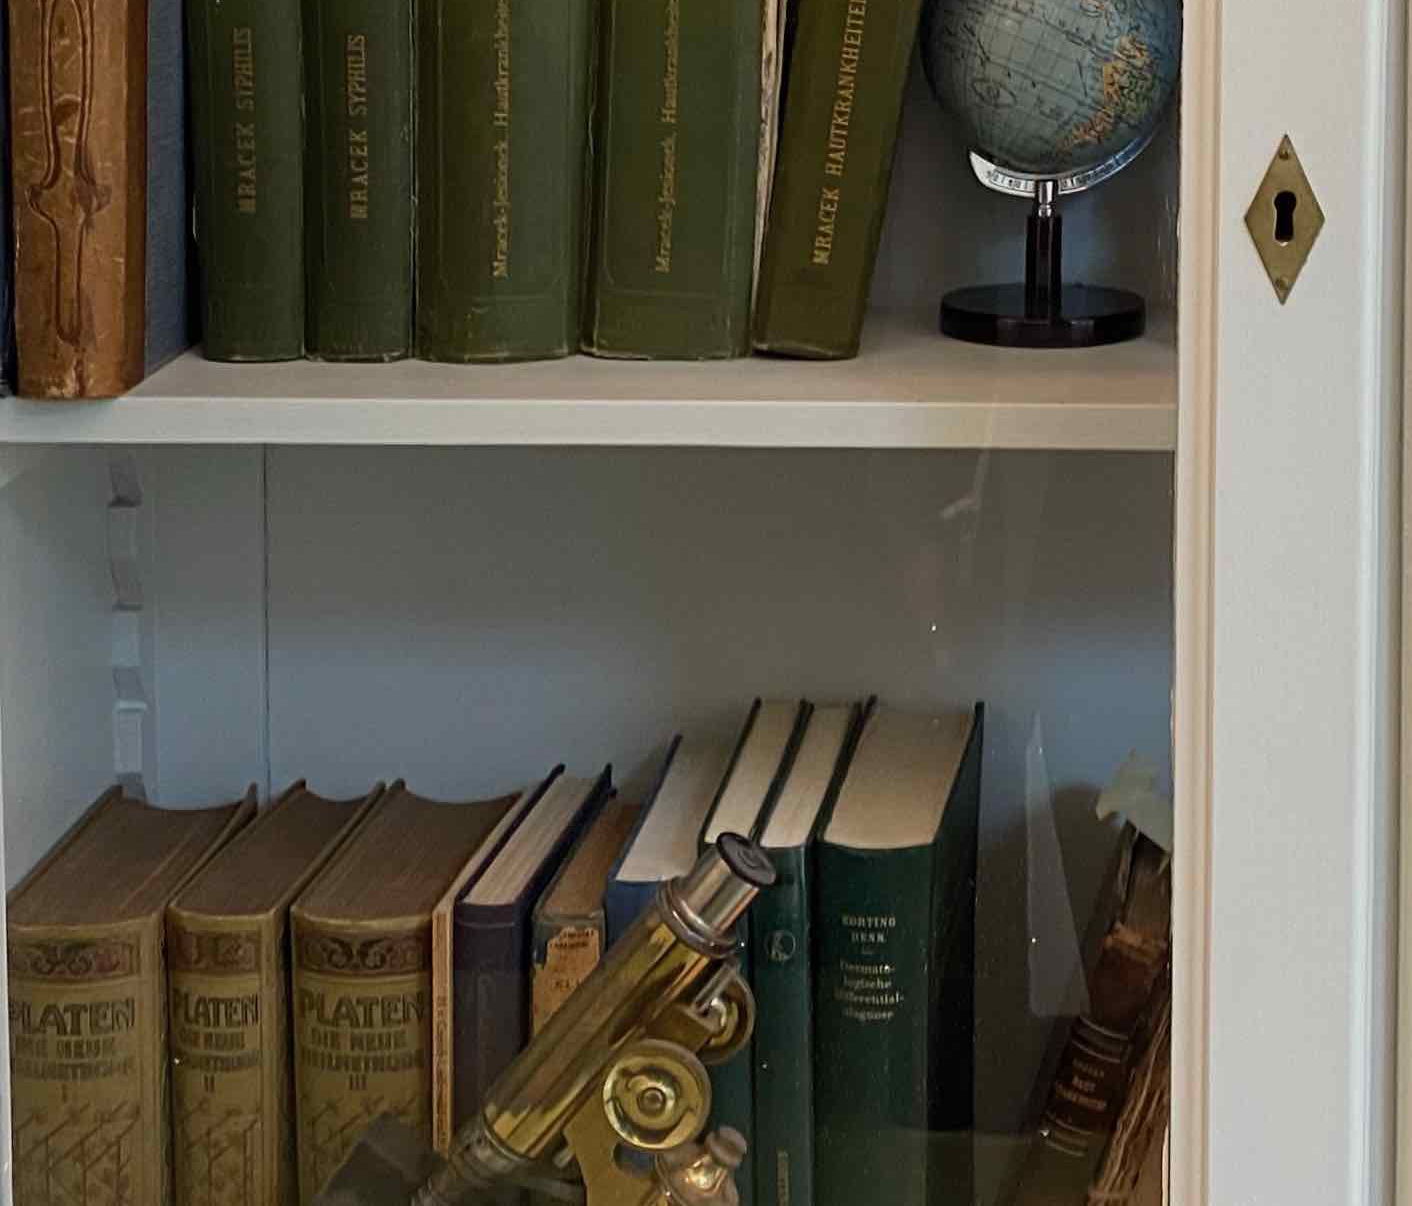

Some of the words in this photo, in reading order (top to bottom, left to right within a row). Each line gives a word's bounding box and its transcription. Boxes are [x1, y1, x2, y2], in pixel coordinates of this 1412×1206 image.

[232, 26, 255, 111] SYPHILIS
[346, 33, 368, 117] SYPHILIS
[235, 119, 257, 214] MRACEK
[348, 129, 369, 220] MRACEK
[812, 185, 840, 266] MRACEK
[302, 988, 424, 1028] PLATEN
